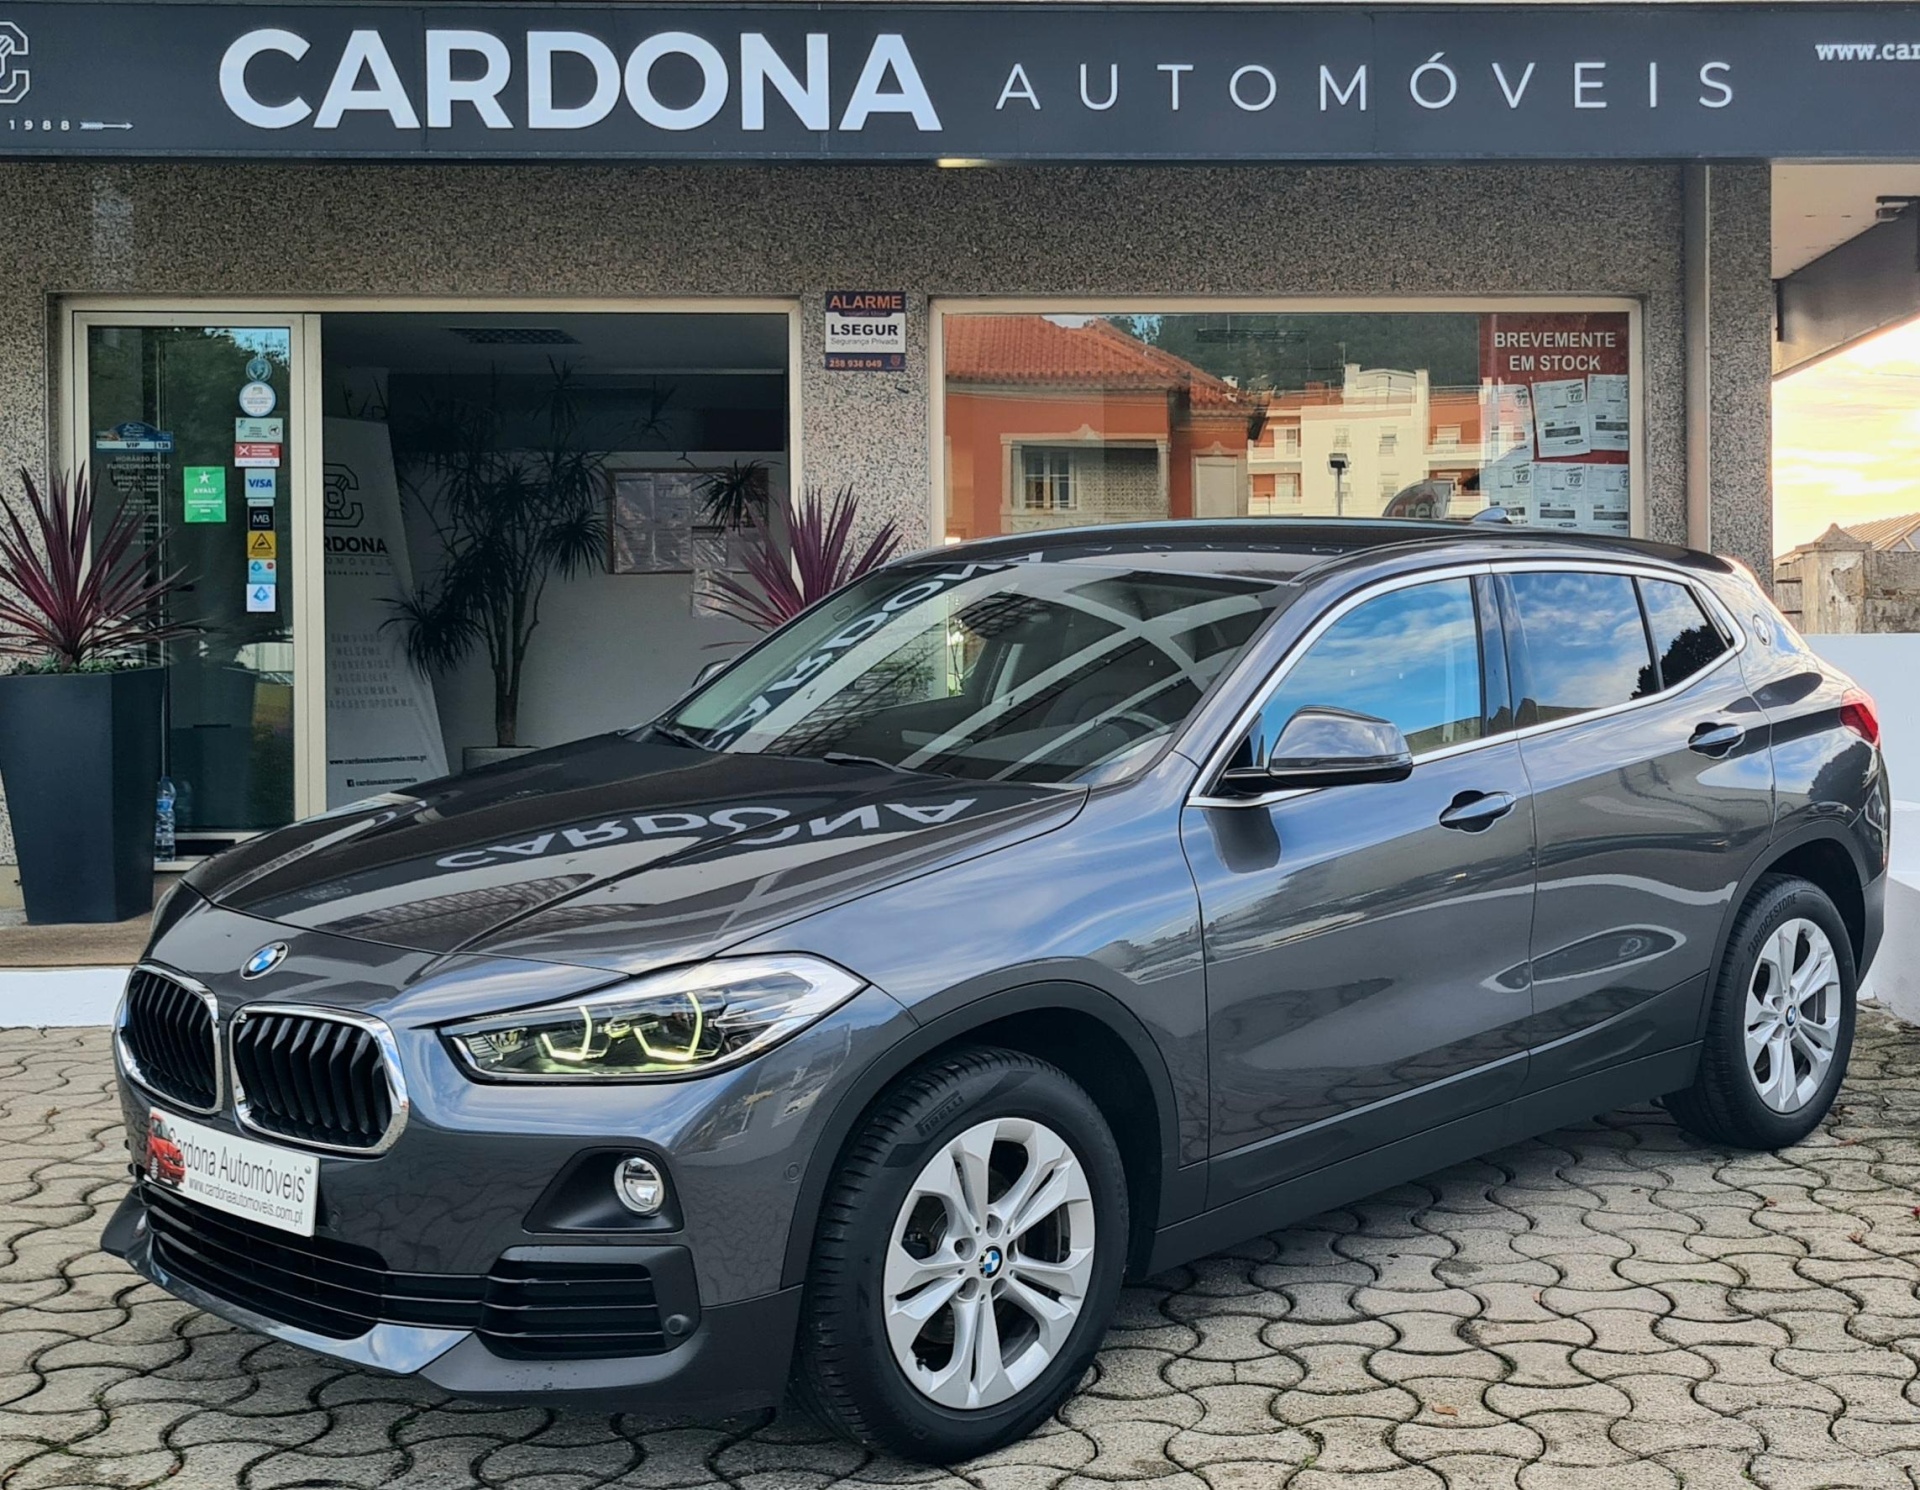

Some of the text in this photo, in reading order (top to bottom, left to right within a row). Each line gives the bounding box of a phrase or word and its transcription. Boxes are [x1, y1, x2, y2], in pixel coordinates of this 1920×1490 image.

[219, 29, 1734, 131] CARDONA AUTOMÓVEIS
[9, 119, 70, 131] 1988
[829, 294, 902, 309] ALARME
[831, 323, 898, 336] LSEGUR
[831, 337, 899, 347] Segurança Privada
[1494, 331, 1616, 348] BREVEMENTE
[1509, 355, 1601, 371] EM STOCK
[248, 479, 272, 488] VISA
[252, 514, 270, 523] MB
[220, 1146, 305, 1203] Automóveis
